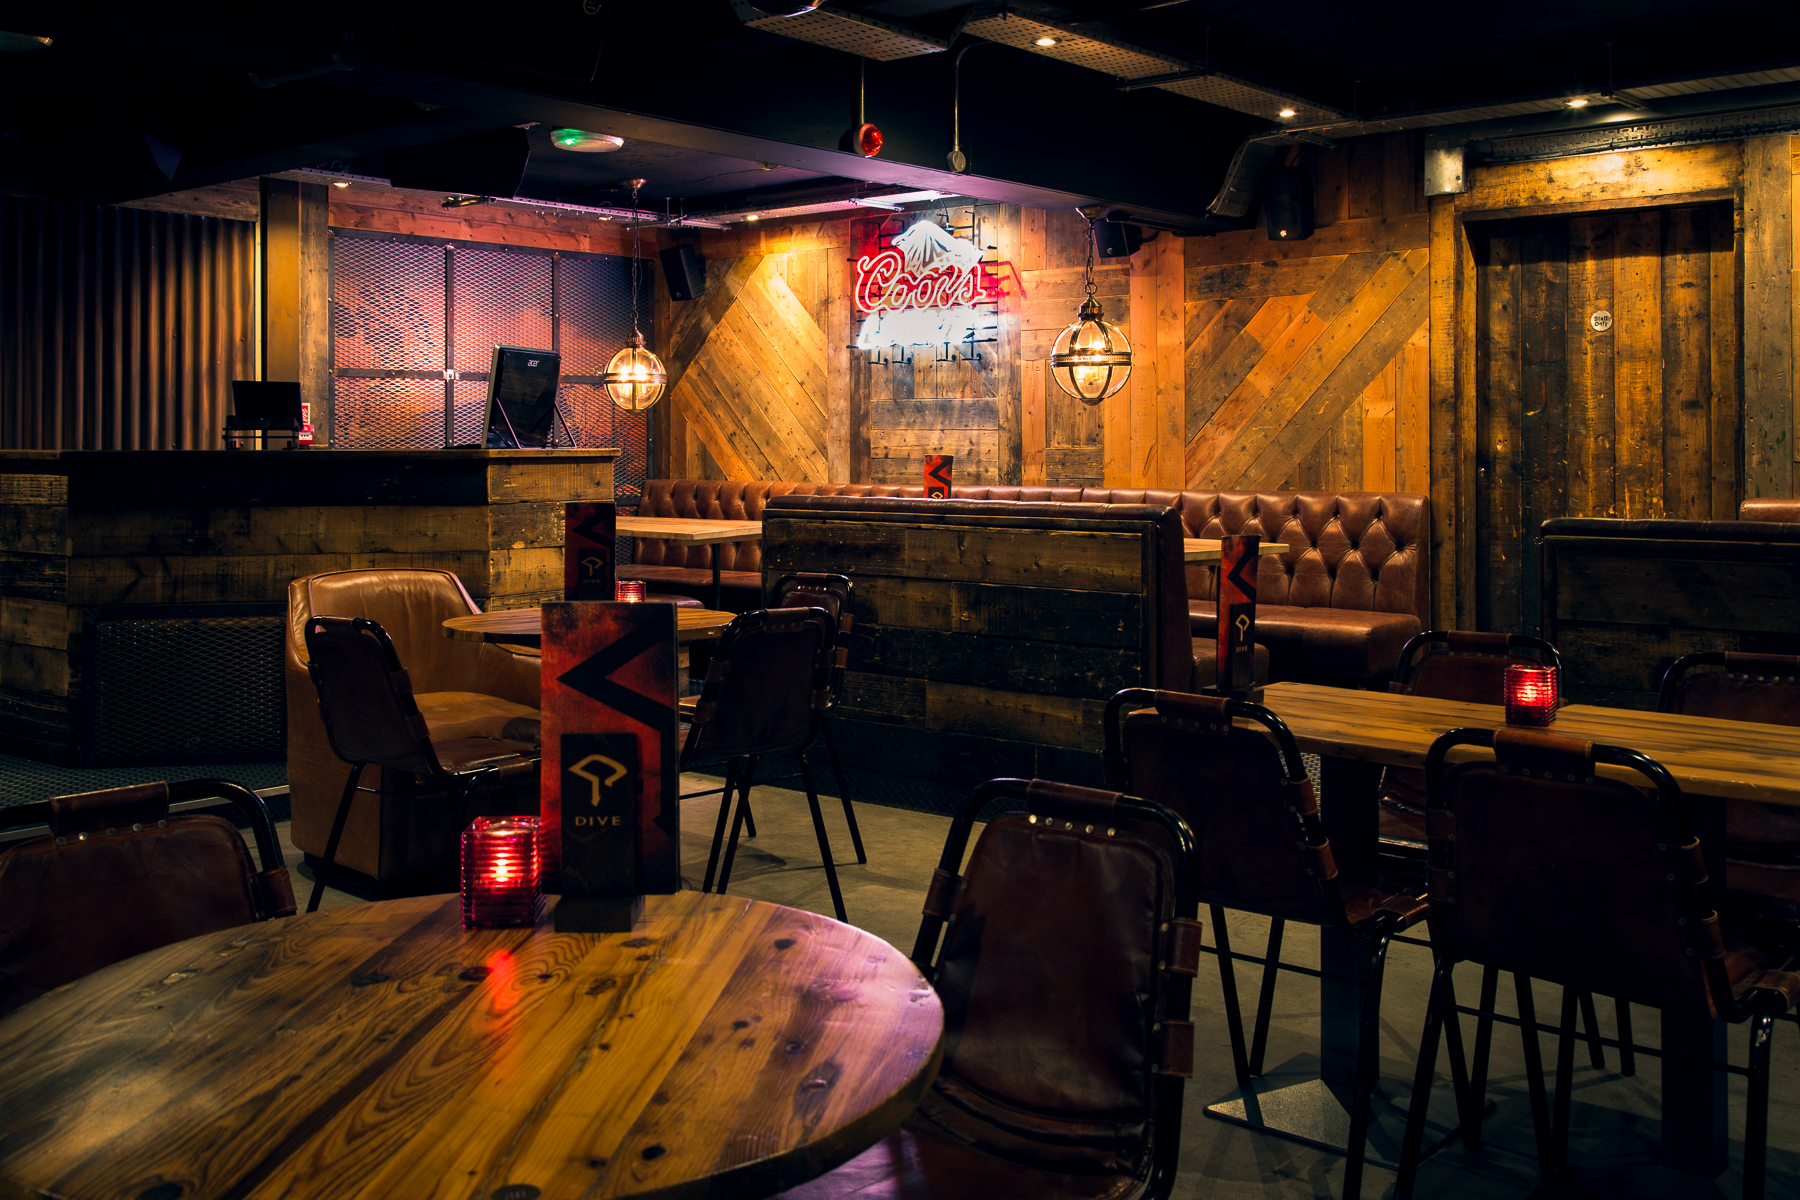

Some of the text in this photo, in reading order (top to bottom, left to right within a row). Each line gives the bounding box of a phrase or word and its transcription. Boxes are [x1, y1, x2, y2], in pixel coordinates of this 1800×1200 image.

[855, 251, 987, 313] Coors
[528, 359, 540, 367] acer
[1236, 645, 1248, 653] DIVE
[574, 815, 622, 827] DIVE
